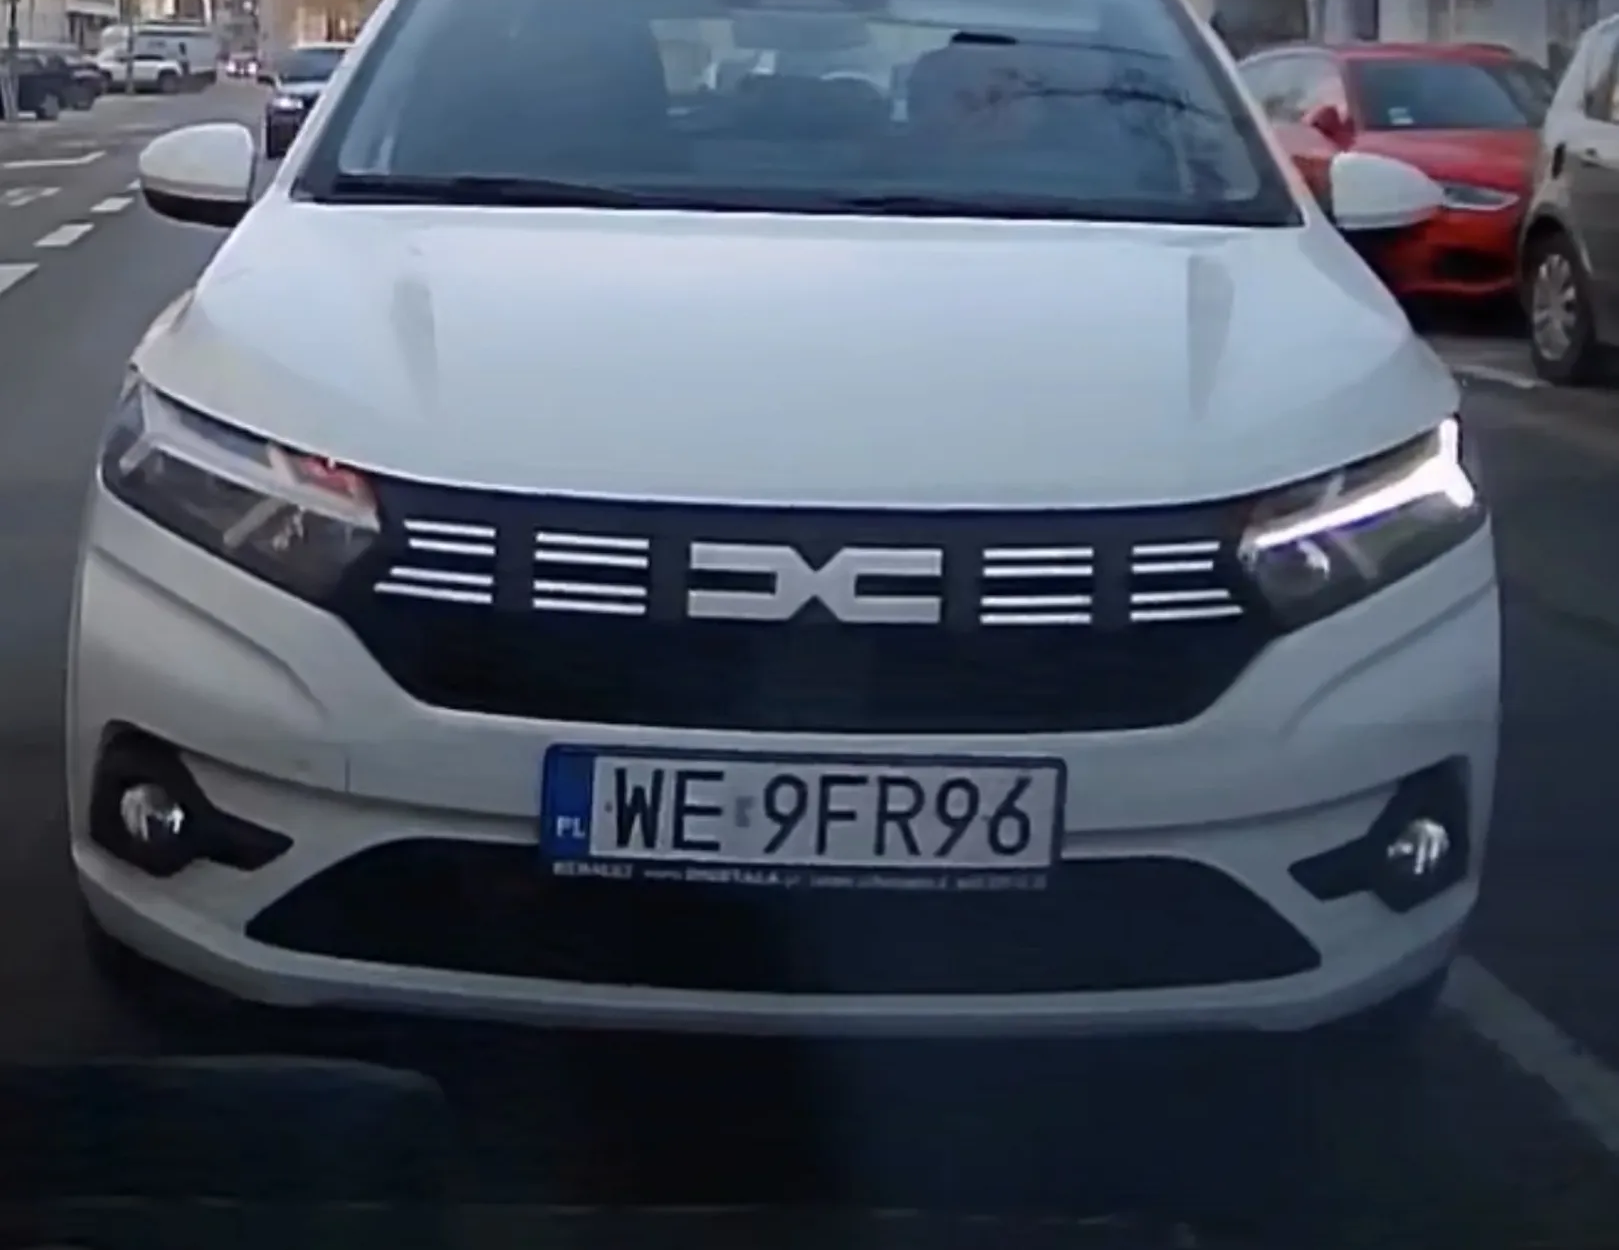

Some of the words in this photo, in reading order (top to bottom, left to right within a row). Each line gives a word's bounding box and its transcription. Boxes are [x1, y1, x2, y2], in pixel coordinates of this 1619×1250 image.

[556, 815, 586, 838] PL
[614, 767, 725, 851] WE
[763, 774, 1032, 857] 9FR96
